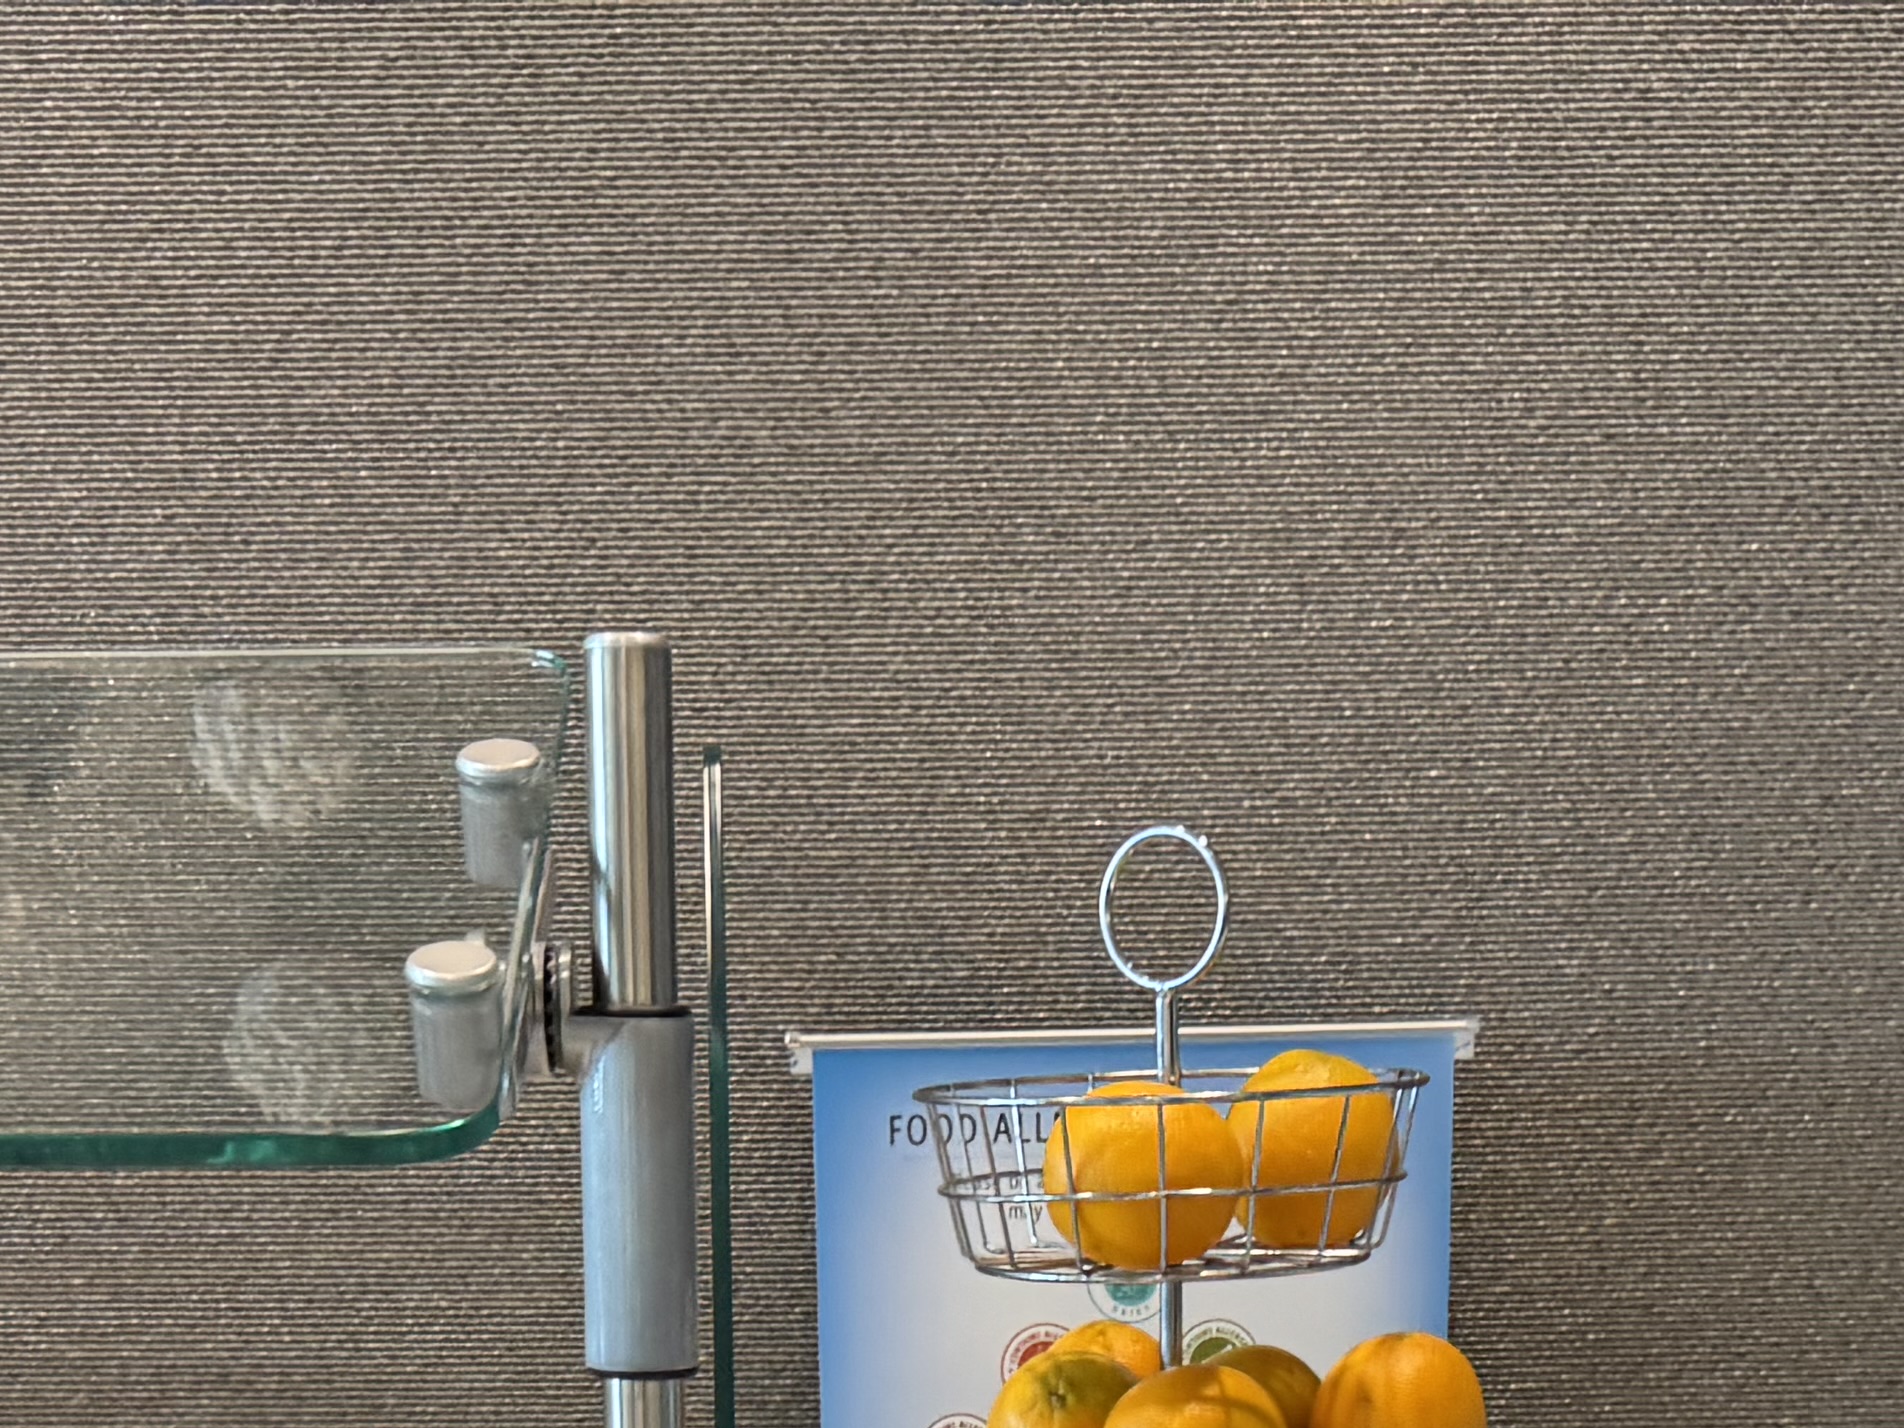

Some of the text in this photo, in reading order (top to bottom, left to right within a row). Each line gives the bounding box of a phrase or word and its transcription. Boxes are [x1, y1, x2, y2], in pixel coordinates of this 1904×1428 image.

[889, 1110, 1061, 1146] FOOD ALL
[1009, 1205, 1043, 1223] my
